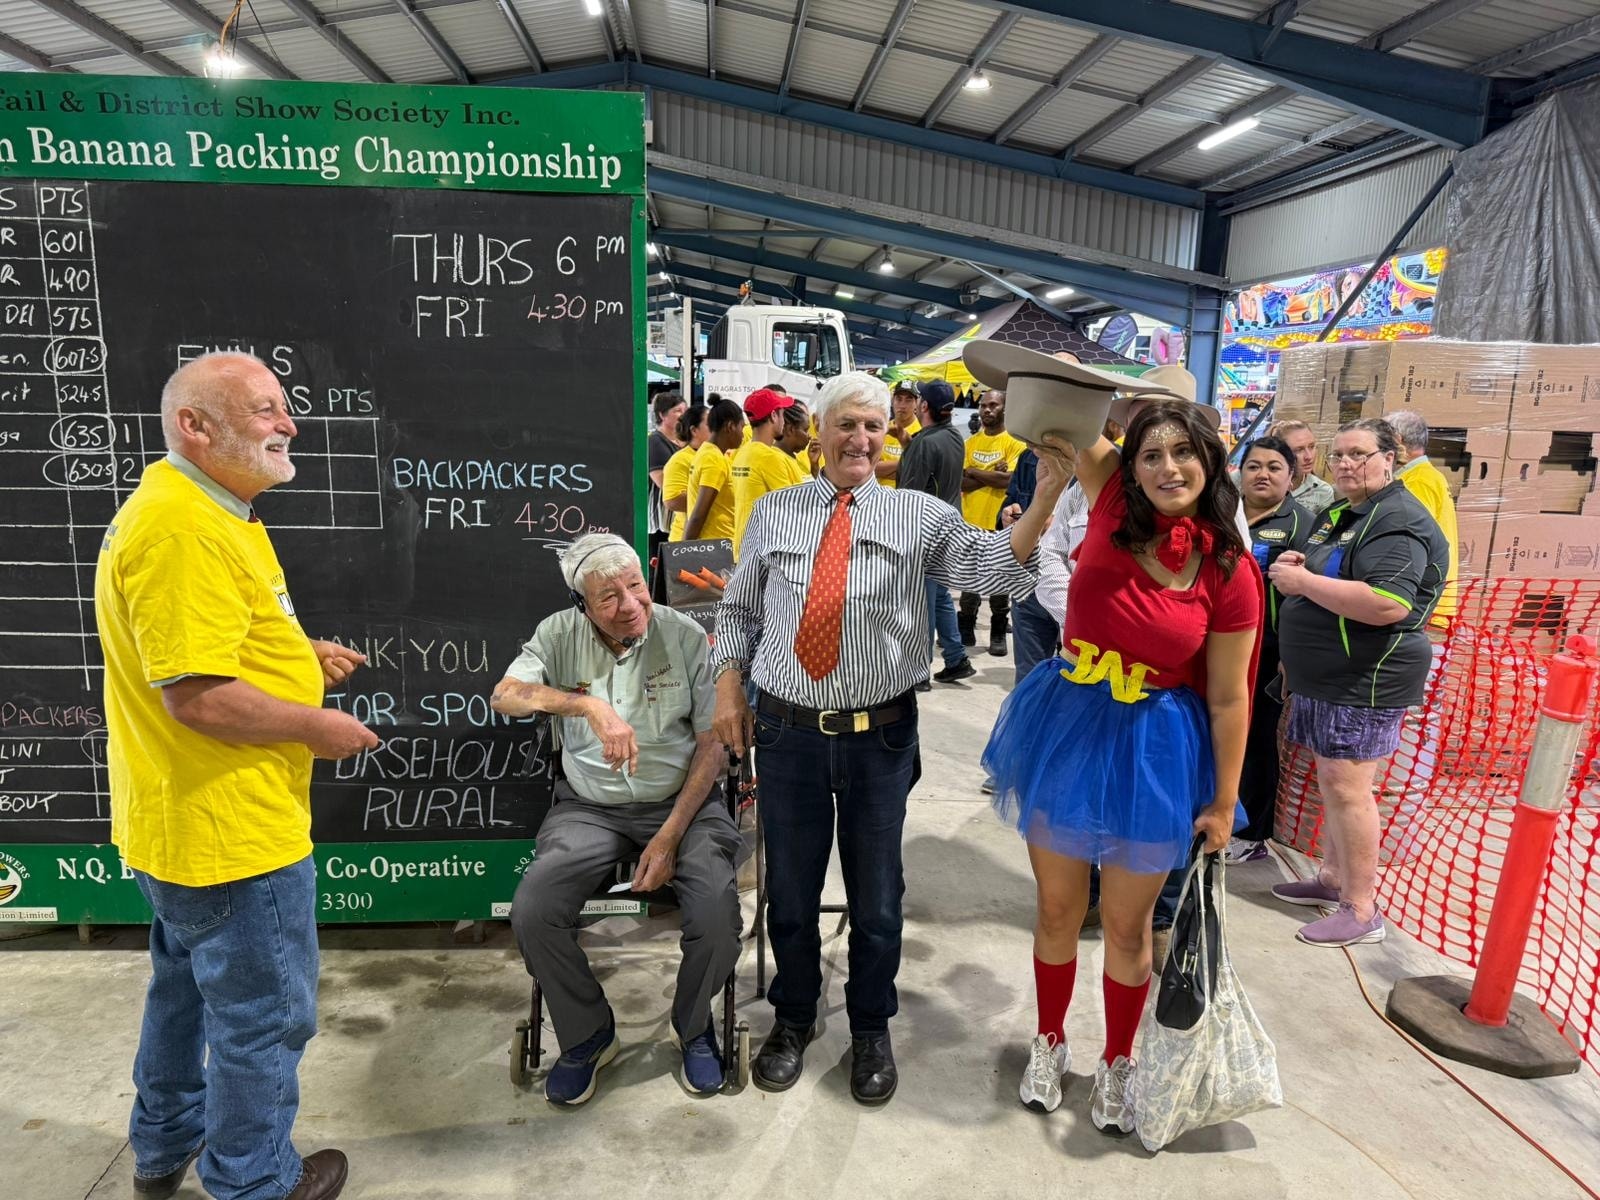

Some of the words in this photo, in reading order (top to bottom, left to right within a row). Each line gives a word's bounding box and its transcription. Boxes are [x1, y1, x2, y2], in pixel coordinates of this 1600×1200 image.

[59, 90, 85, 113] &
[97, 91, 224, 117] District
[235, 95, 322, 120] Show
[334, 99, 450, 129] Society
[462, 103, 520, 126] Inc.
[27, 127, 176, 168] Banana
[186, 131, 340, 180] Packing
[354, 136, 622, 189] Championship
[40, 186, 85, 216] PTS
[44, 229, 83, 254] 601
[392, 233, 534, 286] THURS
[556, 236, 577, 275] 6
[50, 266, 91, 292] 490
[53, 306, 92, 332] 575
[416, 296, 492, 338] FRI
[595, 300, 624, 324] pm
[328, 388, 374, 413] PTS
[64, 420, 105, 448] 635
[124, 423, 131, 444] 1
[122, 457, 141, 482] 2
[392, 458, 594, 494] BACKPACKERS
[424, 498, 491, 530] FRI
[1, 701, 103, 727] PACKERS
[363, 785, 513, 831] RURAL
[56, 857, 112, 884] N.Q.
[325, 855, 487, 883] Co-Operative
[321, 892, 374, 911] 3300
[603, 902, 638, 912] Limited
[19, 911, 55, 920] Limited
